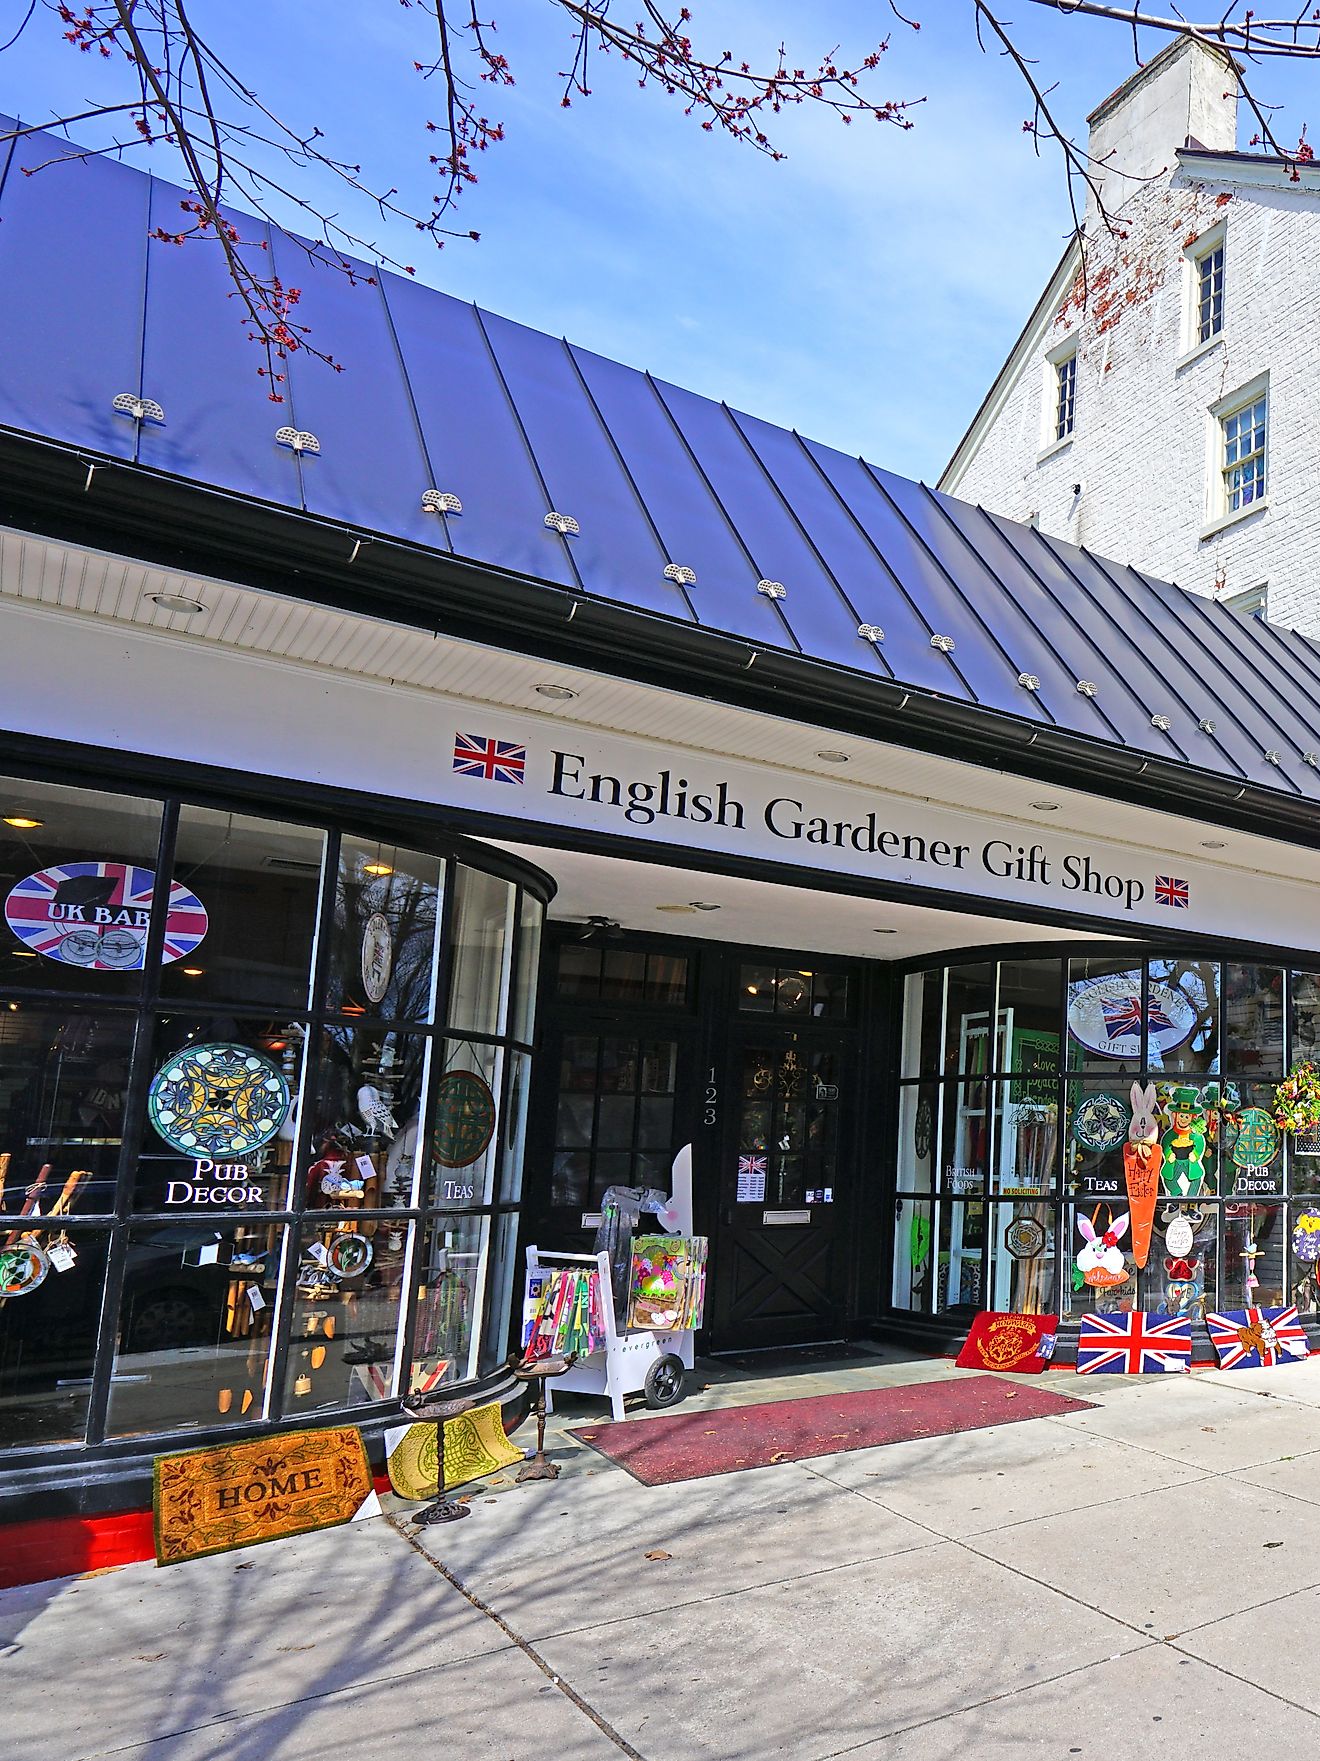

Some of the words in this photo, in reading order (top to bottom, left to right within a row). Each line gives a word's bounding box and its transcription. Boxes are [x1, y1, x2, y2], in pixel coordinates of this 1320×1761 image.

[548, 750, 746, 830] English
[764, 797, 970, 869] Gardener
[982, 839, 1051, 886] Gift
[1062, 855, 1145, 911] Shop
[48, 902, 86, 923] UK
[1127, 980, 1189, 1014] GRDENER
[1098, 1040, 1127, 1054] GIFT
[192, 1158, 249, 1181] PUB
[946, 1165, 975, 1177] BRITISH
[1246, 1163, 1269, 1177] PUB
[444, 1180, 474, 1199] TEAS
[947, 1177, 974, 1190] FOODS
[1011, 1187, 1039, 1195] SOLICITING
[1083, 1177, 1118, 1191] TEAS
[1237, 1178, 1276, 1191] DECOR
[164, 1181, 264, 1204] DECOR
[1171, 1286, 1193, 1299] LVE
[621, 1336, 674, 1353] evergreen
[215, 1467, 324, 1511] HOME
